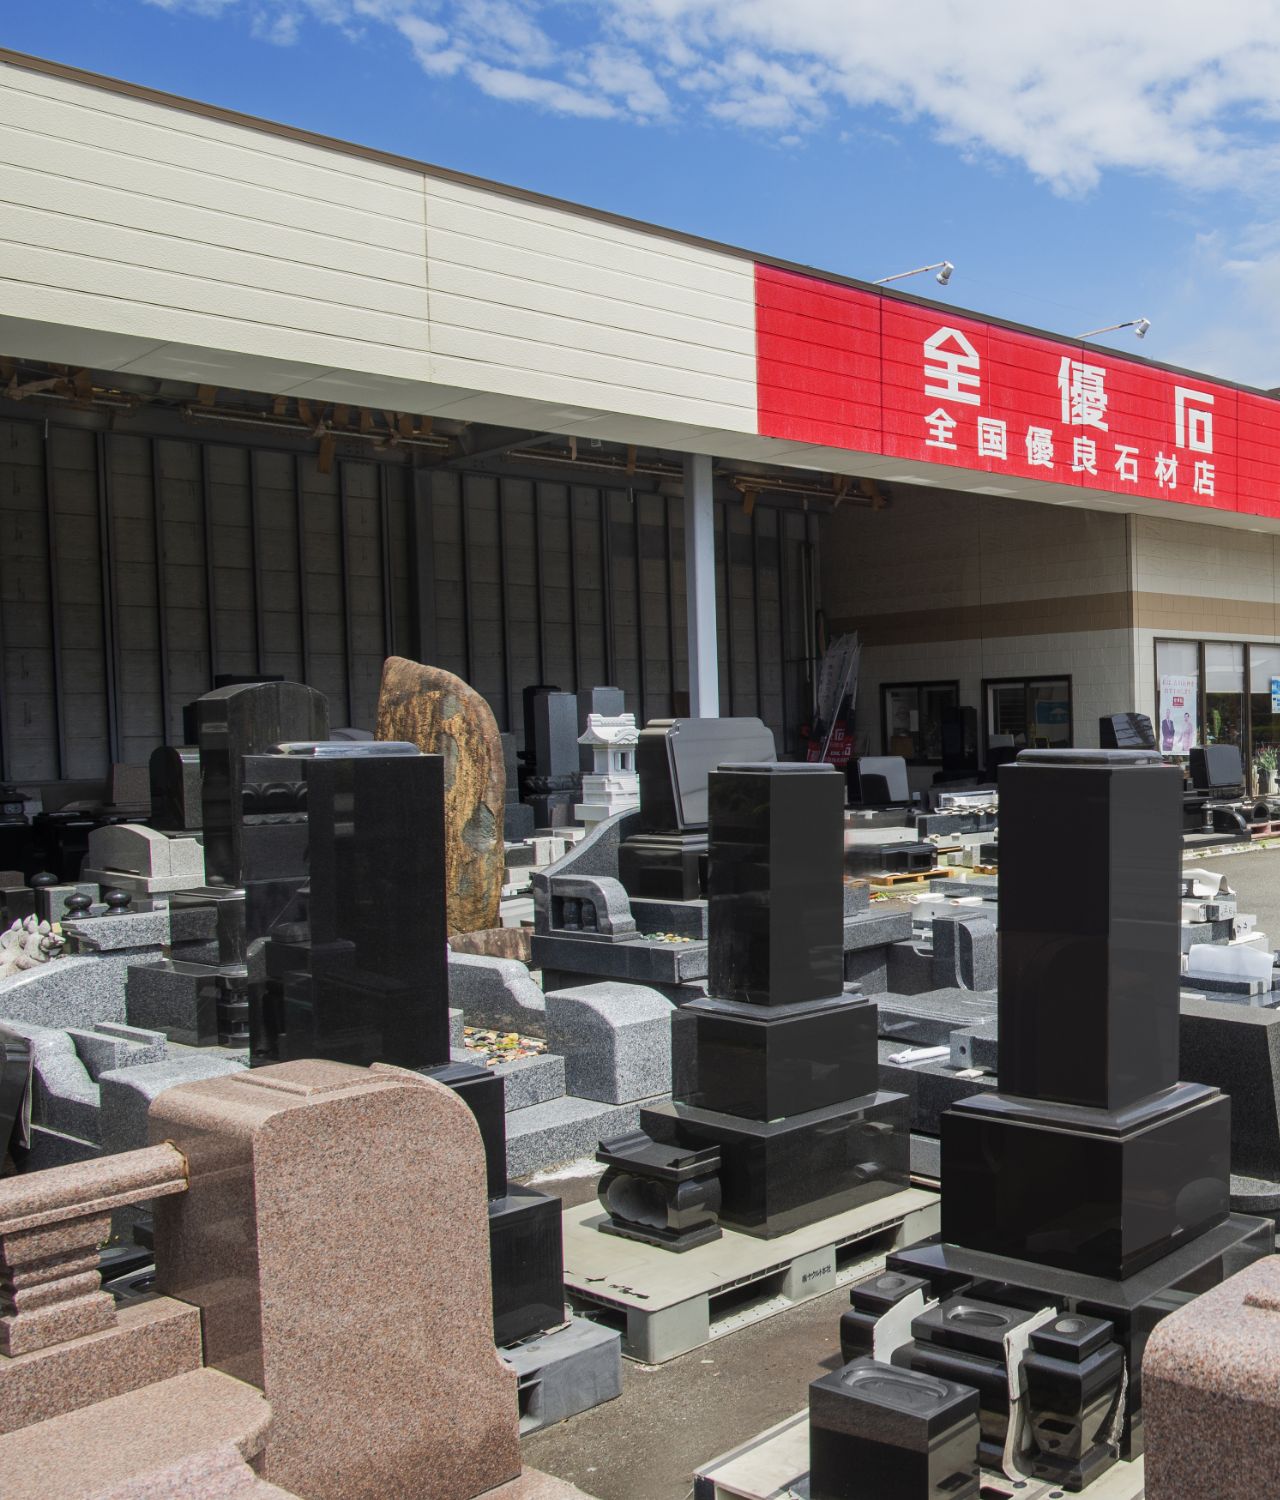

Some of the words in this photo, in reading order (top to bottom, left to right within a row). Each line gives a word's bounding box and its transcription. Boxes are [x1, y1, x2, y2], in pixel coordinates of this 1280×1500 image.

[924, 326, 1215, 454] 全優石
[924, 407, 1216, 497] 全国優良石材店
